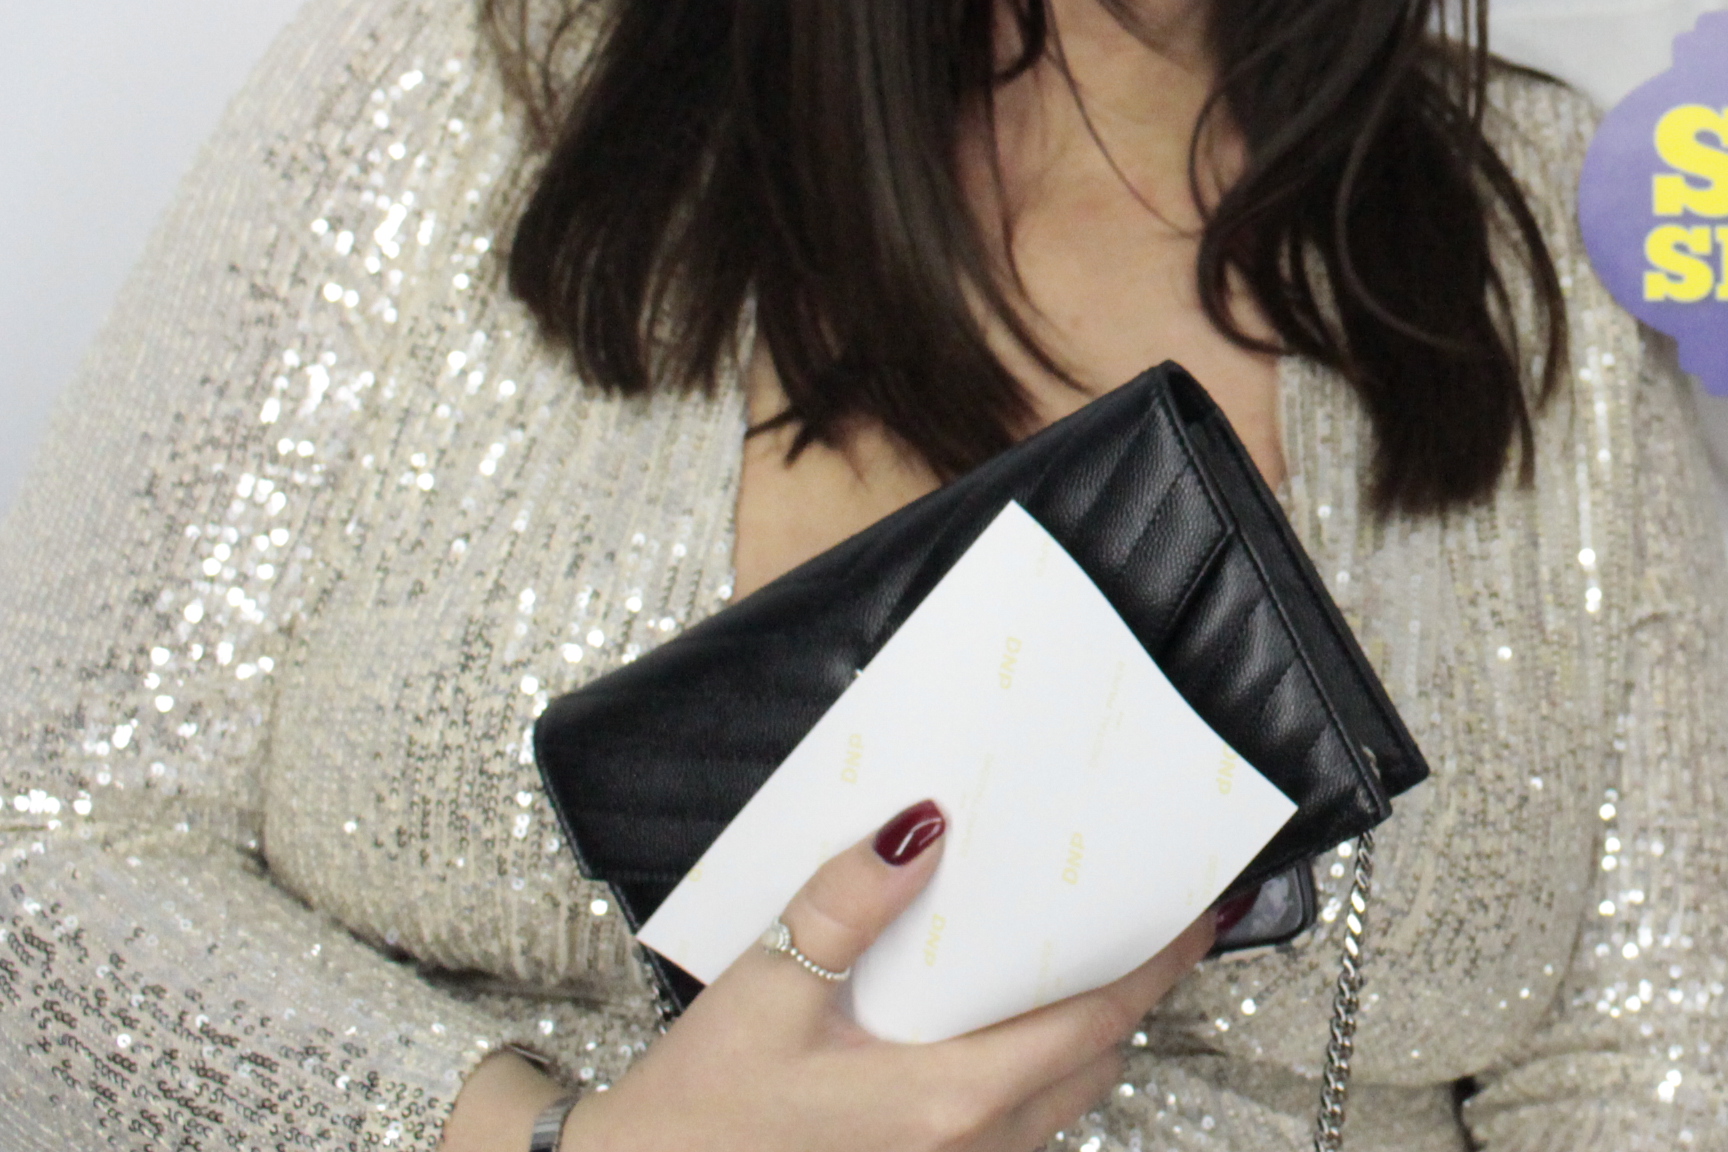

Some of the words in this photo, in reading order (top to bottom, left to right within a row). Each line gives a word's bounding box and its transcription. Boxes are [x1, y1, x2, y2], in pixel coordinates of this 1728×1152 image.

[997, 635, 1022, 690] DNP
[840, 733, 864, 784] DNP
[1060, 831, 1085, 886] DNP
[924, 913, 947, 967] DNP
